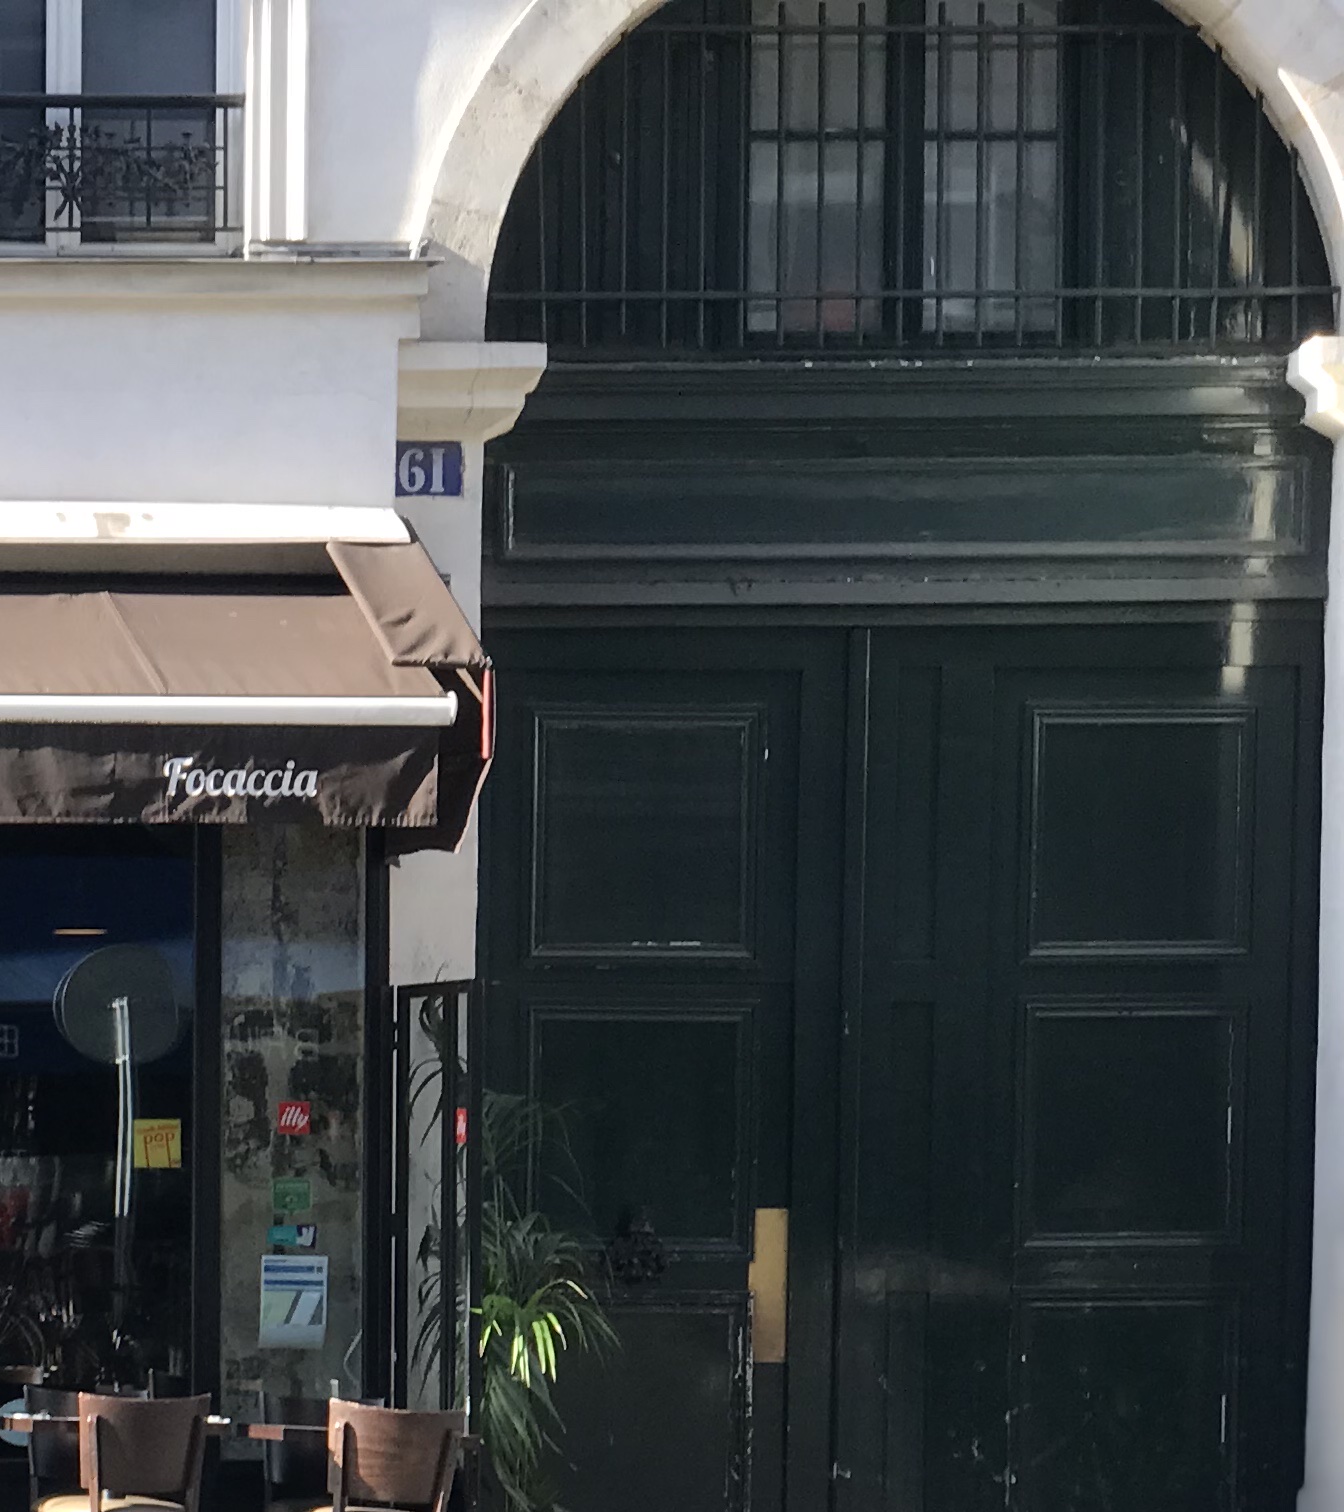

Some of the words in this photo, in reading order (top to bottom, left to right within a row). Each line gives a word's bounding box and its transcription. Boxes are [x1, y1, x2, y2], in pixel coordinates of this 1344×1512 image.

[398, 447, 445, 494] 61
[162, 756, 319, 798] Focaccia
[280, 1105, 309, 1132] illy
